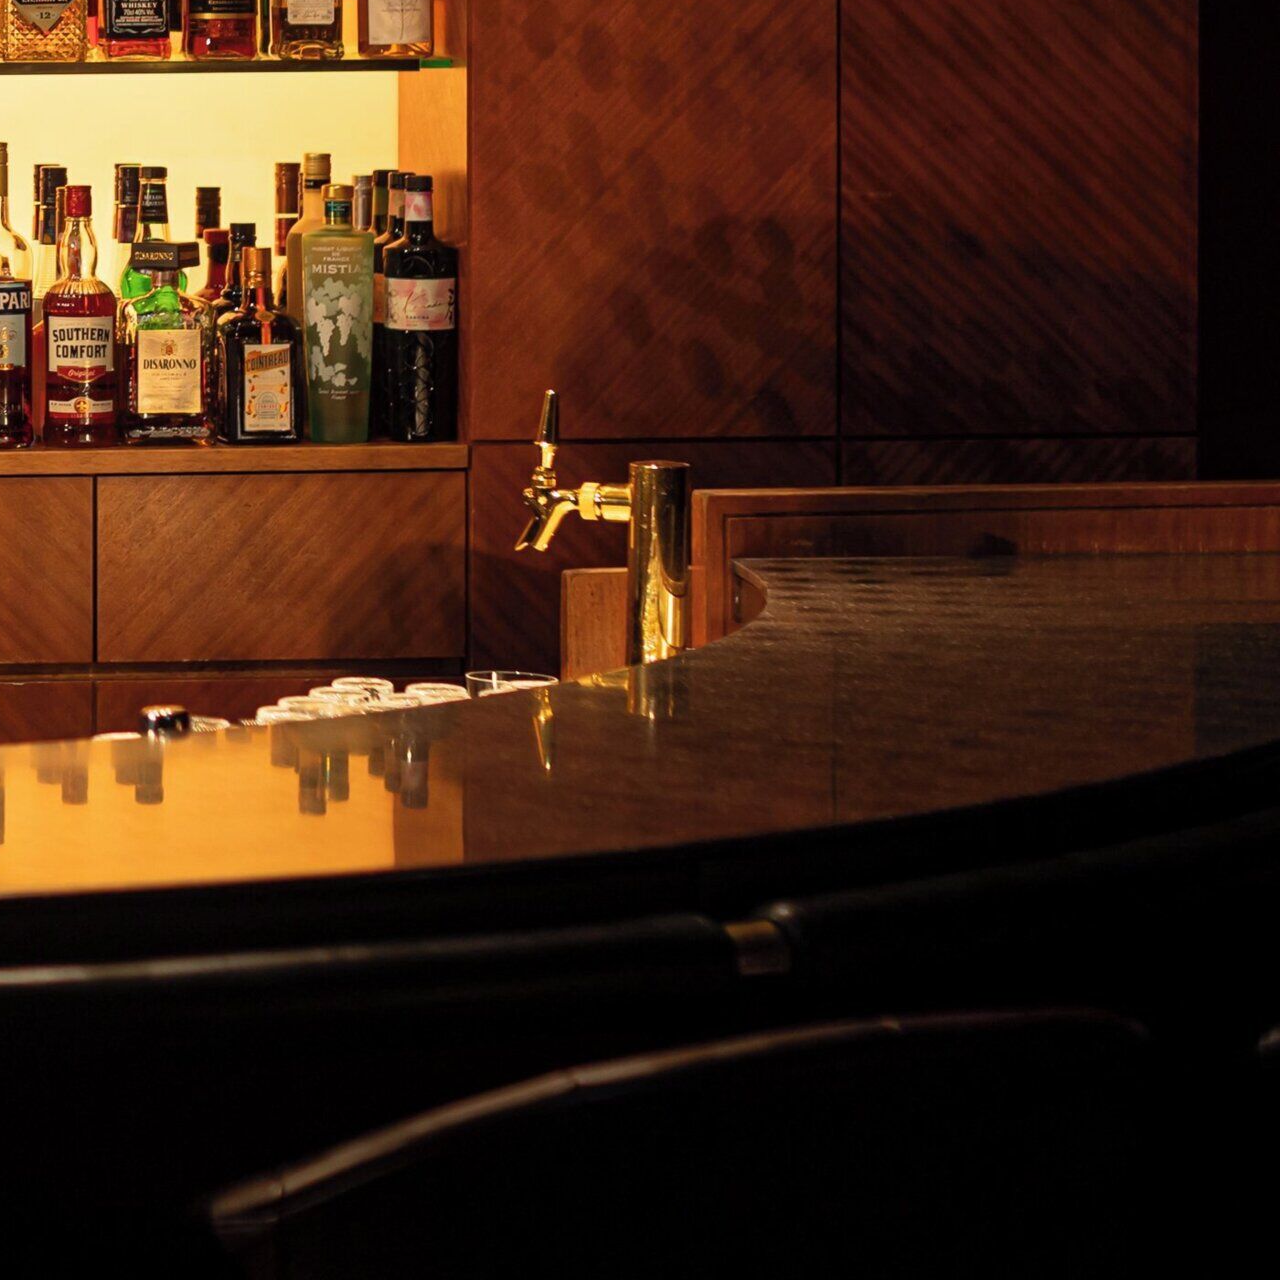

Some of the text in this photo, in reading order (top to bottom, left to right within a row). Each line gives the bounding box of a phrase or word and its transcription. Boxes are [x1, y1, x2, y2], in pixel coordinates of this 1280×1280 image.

[39, 11, 51, 20] 12
[311, 264, 361, 274] MISTIA
[52, 327, 110, 343] SOUTHERN
[55, 344, 108, 359] COMFORT
[143, 358, 197, 370] DISARONNO
